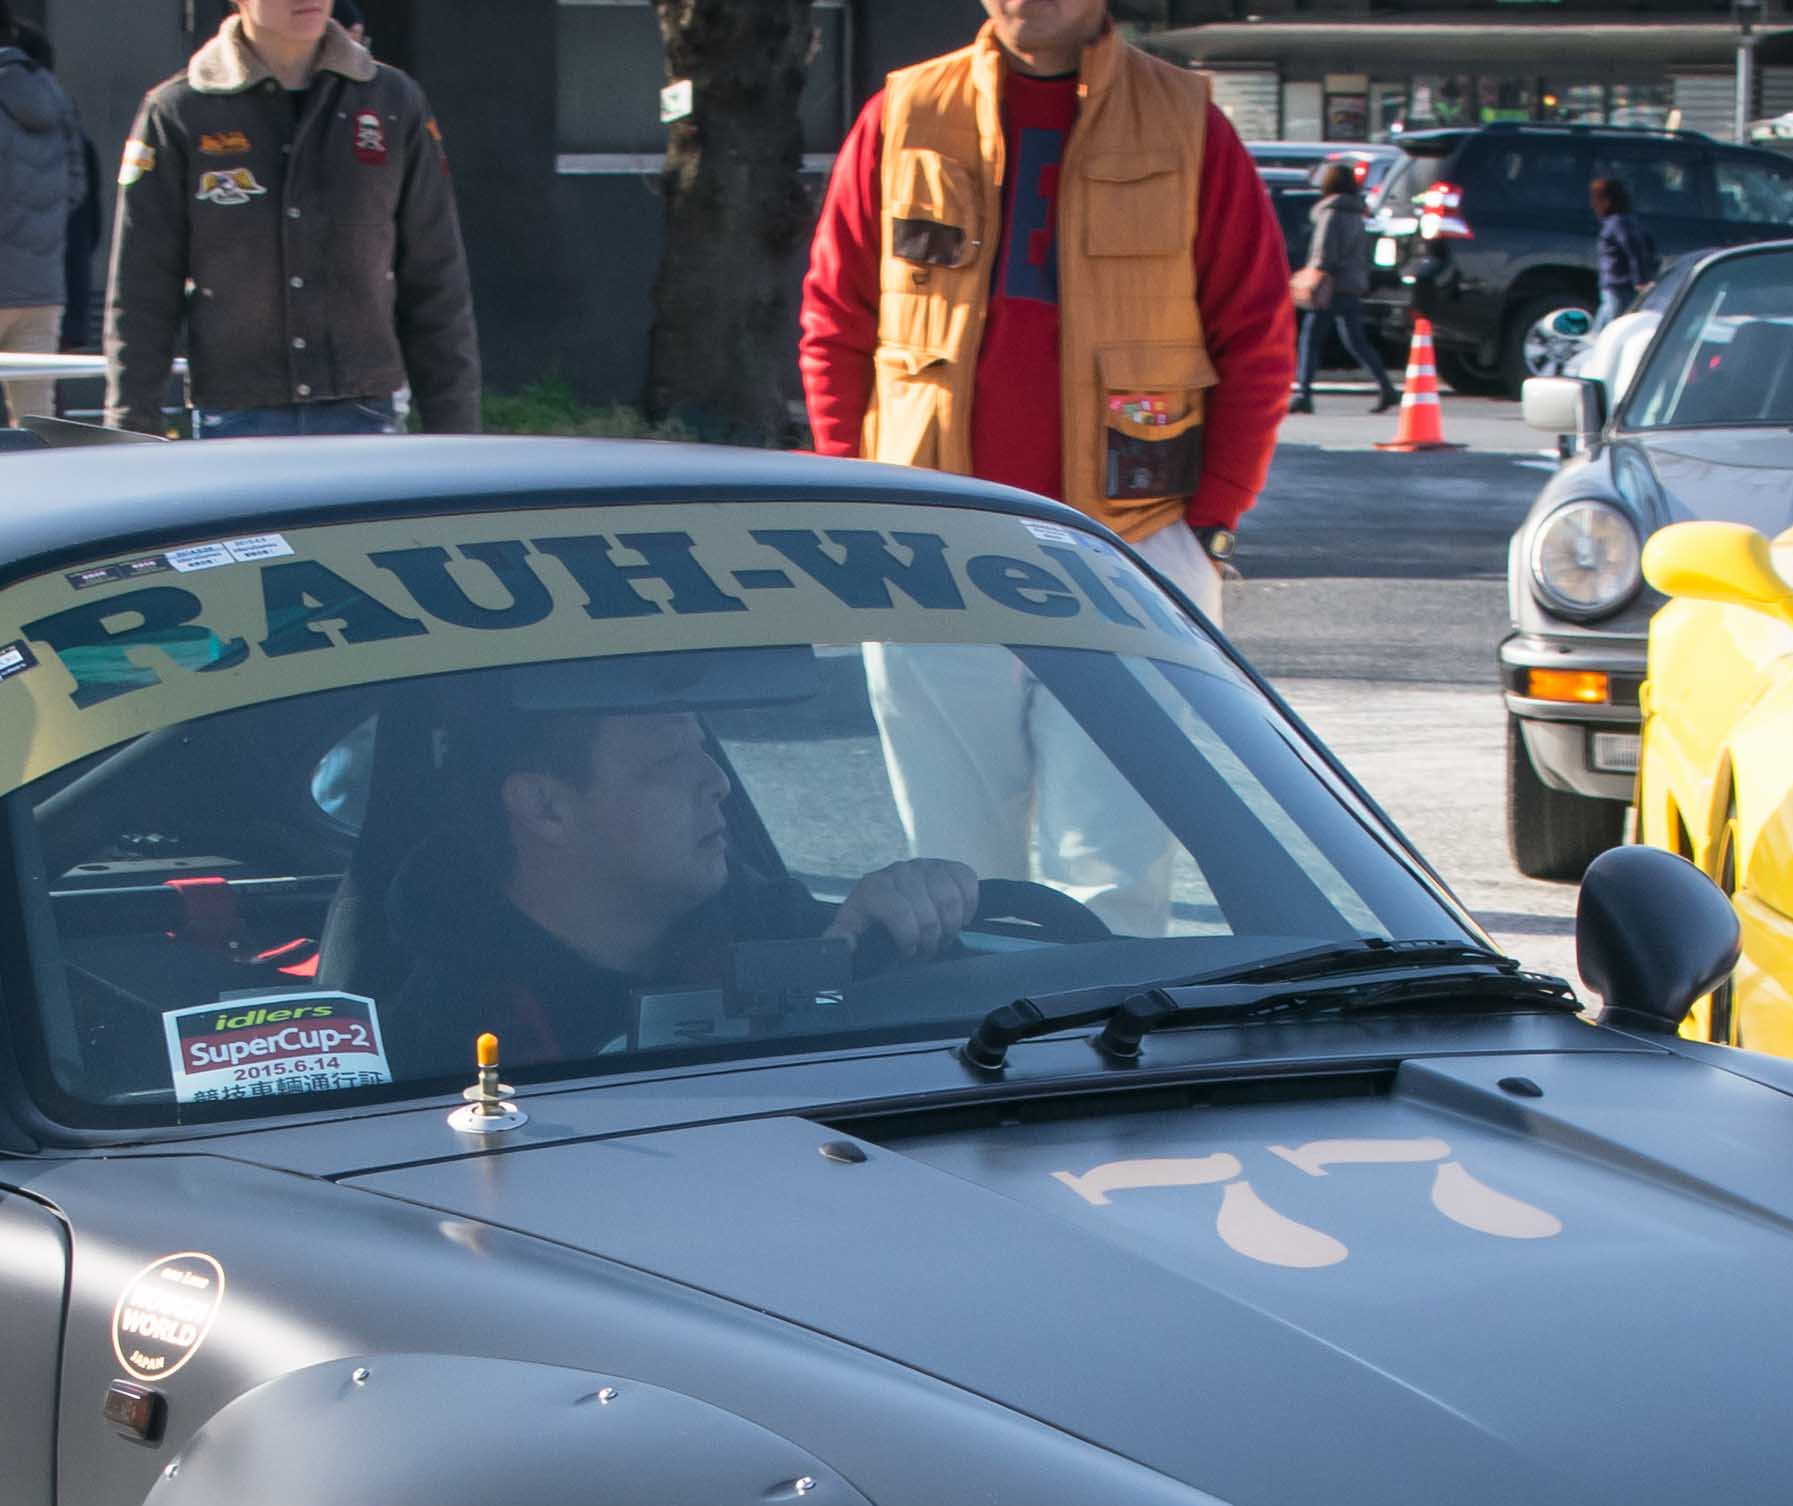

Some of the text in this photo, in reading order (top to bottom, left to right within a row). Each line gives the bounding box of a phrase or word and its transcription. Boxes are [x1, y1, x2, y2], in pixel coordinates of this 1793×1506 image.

[214, 1005, 334, 1031] idlers
[190, 1024, 371, 1066] SuperCup-2
[233, 1056, 341, 1082] 2015.6.14
[1050, 1137, 1563, 1268] 77
[129, 1350, 165, 1370] JAPAN
